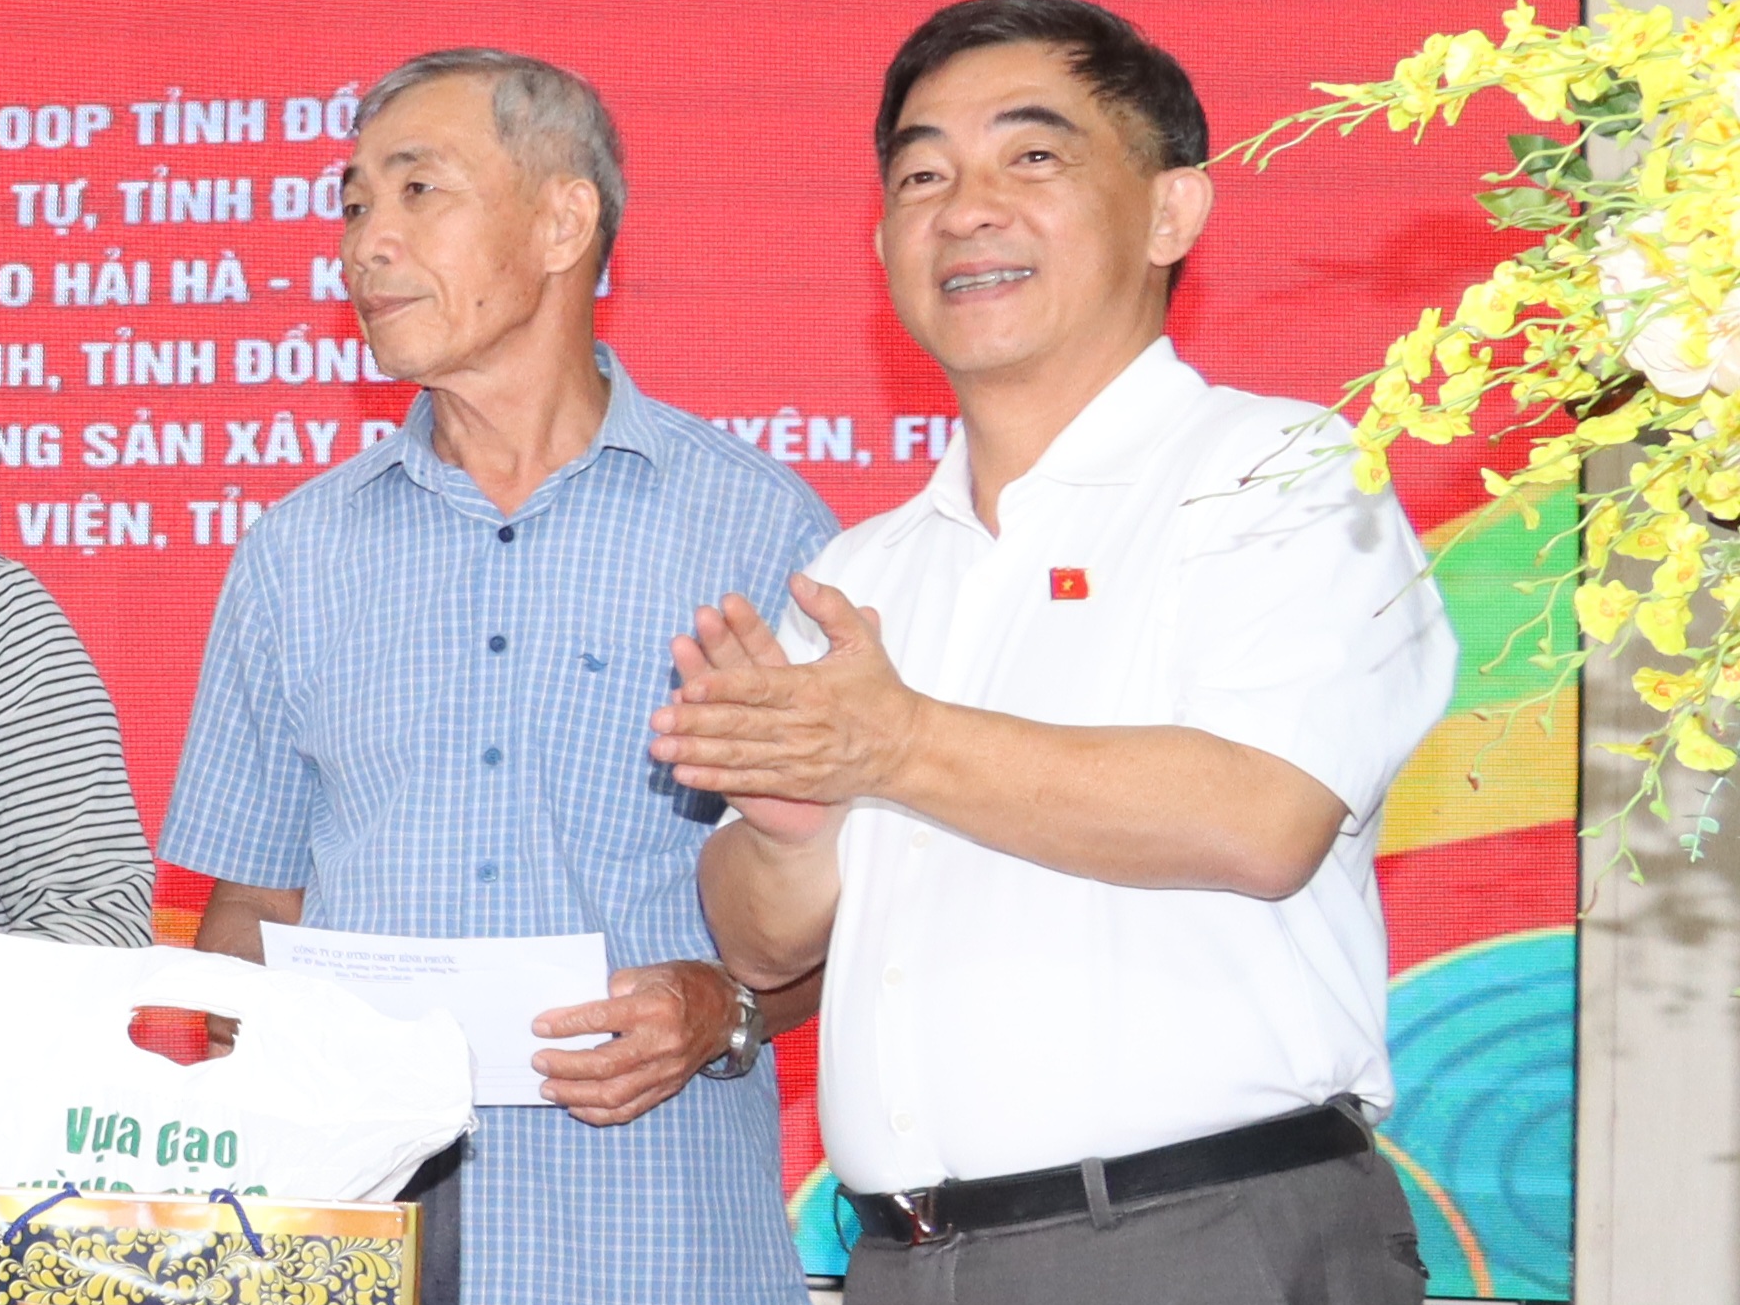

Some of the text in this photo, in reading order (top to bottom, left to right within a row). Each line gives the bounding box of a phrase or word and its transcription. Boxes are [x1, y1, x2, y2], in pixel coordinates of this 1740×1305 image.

[130, 87, 266, 146] TỈNH
[283, 82, 360, 142] ĐỒ
[11, 178, 97, 236] TỰ,
[117, 165, 252, 224] TỈNH
[270, 160, 346, 221] ĐỒ
[54, 248, 151, 306] HẢI
[171, 250, 249, 303] HÀ
[81, 327, 216, 386] TỈNH
[234, 324, 393, 384] ĐỒNG
[224, 411, 338, 465] XÂY
[17, 493, 167, 556] VIỆN,
[65, 1105, 239, 1172] Vựa Gạo
